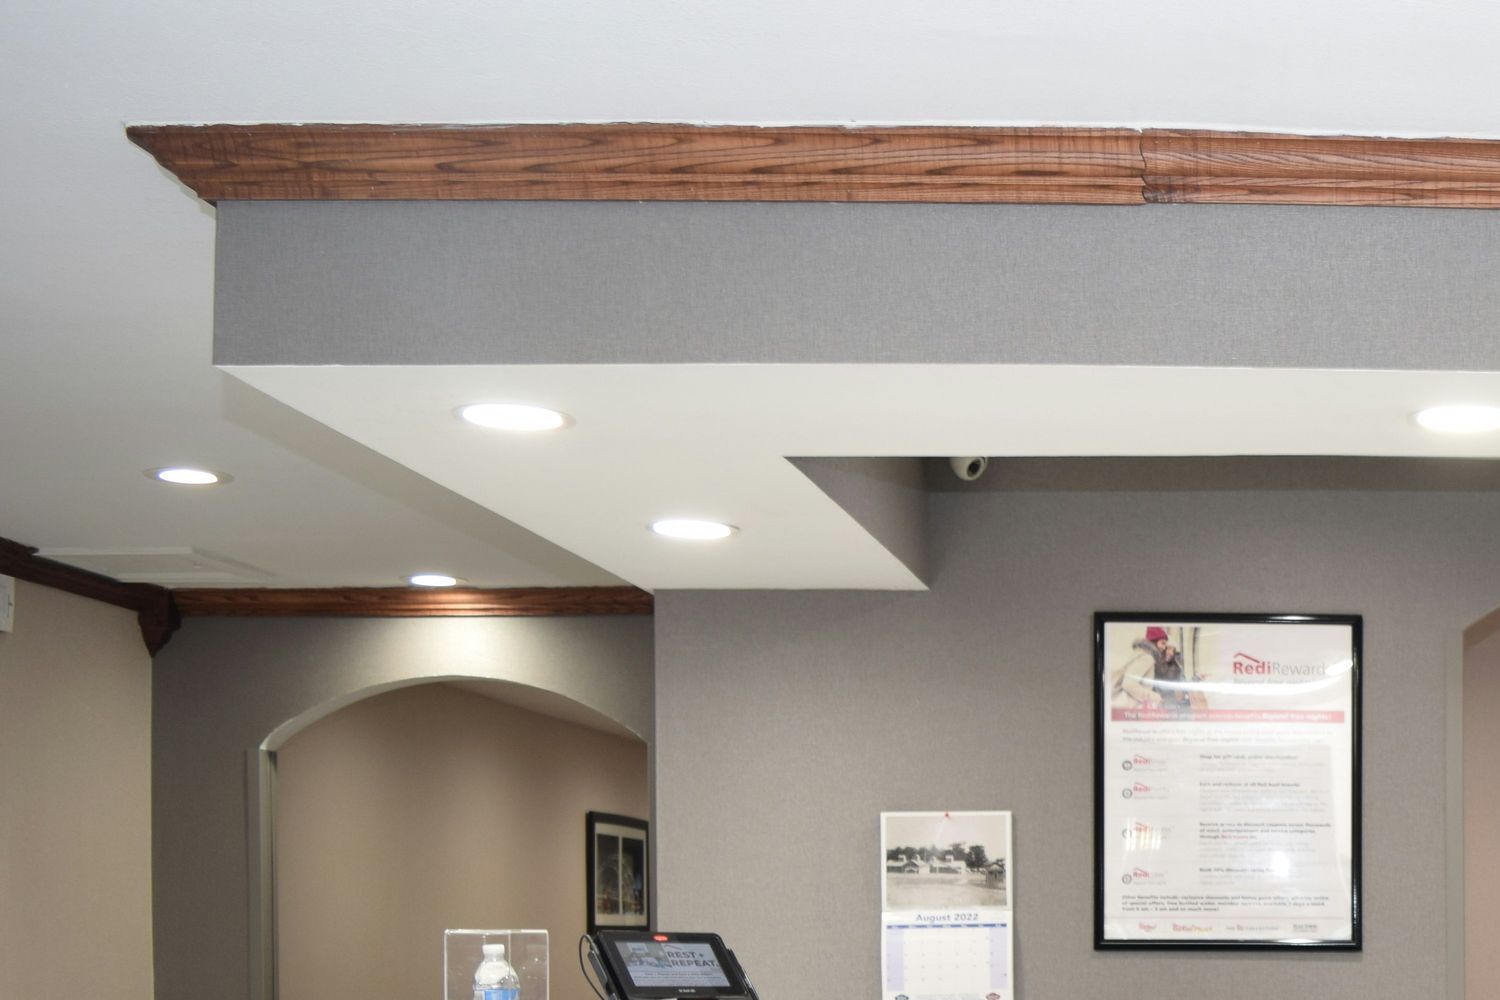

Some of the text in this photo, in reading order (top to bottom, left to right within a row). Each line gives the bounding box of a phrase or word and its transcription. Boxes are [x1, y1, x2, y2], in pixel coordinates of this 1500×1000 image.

[916, 913, 979, 923] August 2022
[667, 951, 696, 959] REST
